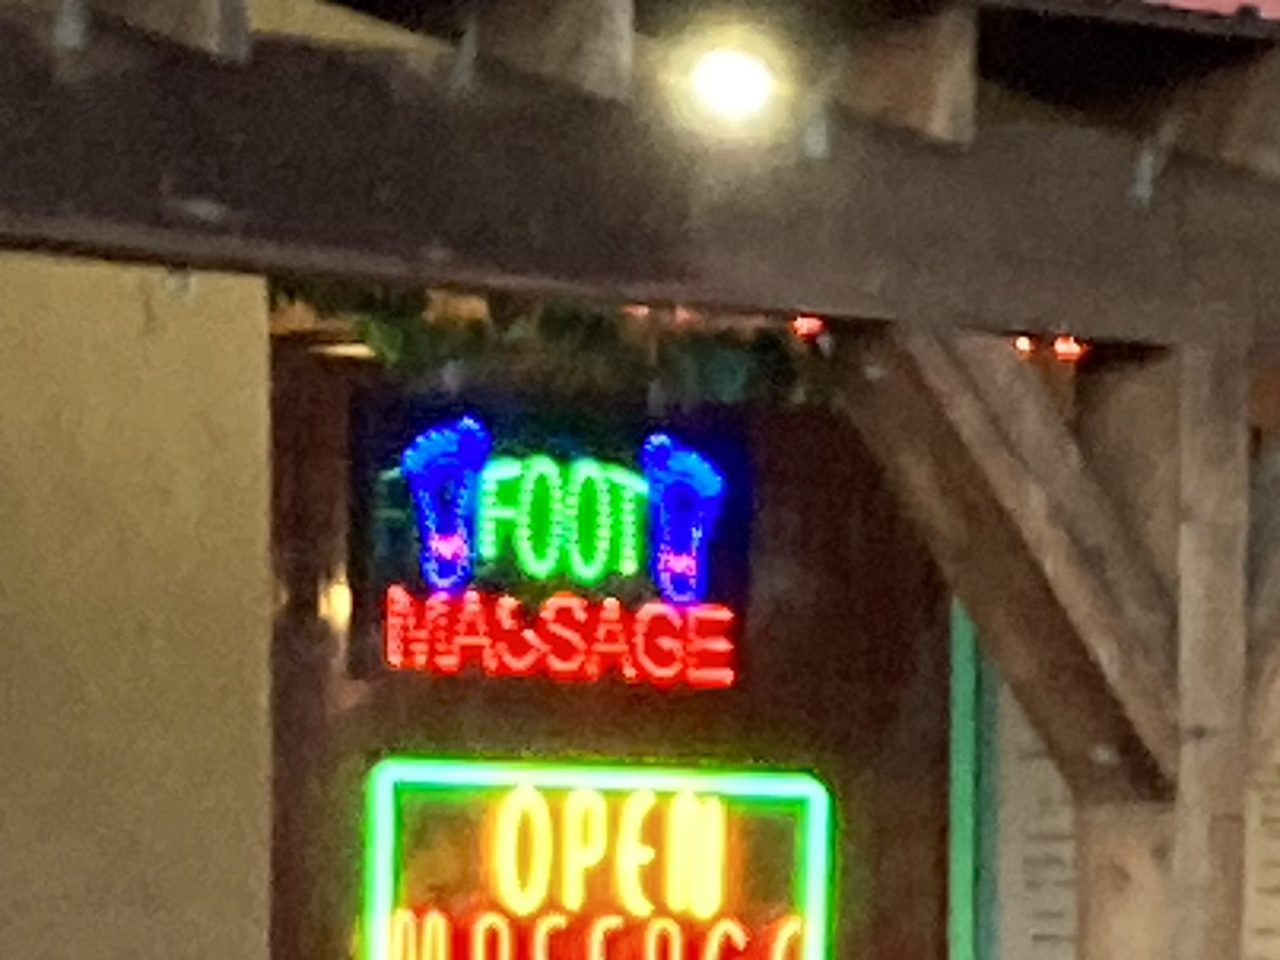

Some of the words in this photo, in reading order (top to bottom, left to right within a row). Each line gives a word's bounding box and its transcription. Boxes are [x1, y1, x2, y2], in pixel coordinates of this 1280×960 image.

[476, 456, 650, 582] FOOT
[384, 583, 736, 690] MASSAGE
[494, 782, 728, 922] OPEN
